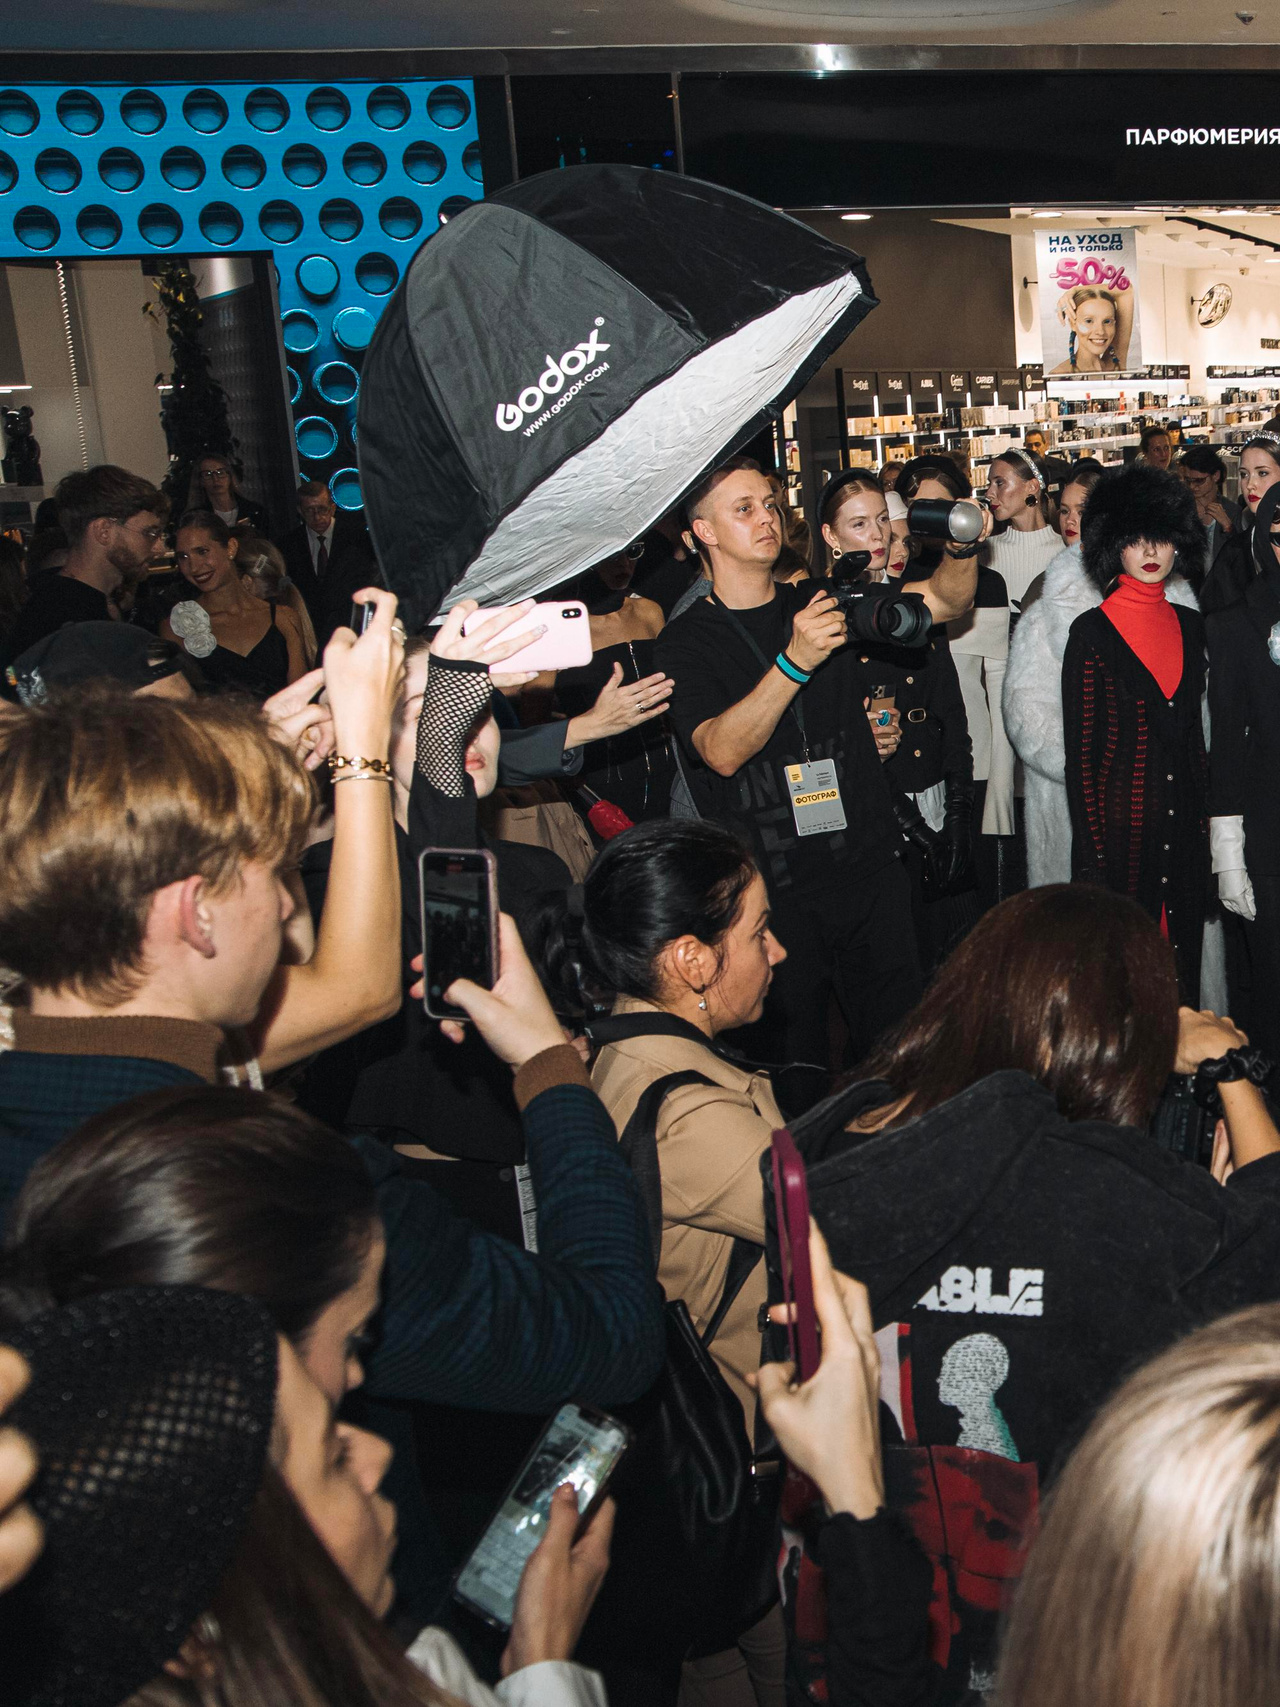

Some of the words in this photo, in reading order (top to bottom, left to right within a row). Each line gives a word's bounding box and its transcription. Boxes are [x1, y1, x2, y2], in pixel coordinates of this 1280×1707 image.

[1048, 236, 1072, 246] НА
[1076, 233, 1123, 245] УХОД
[1078, 243, 1124, 252] только
[523, 362, 610, 437] WWW.GODOX.COM
[795, 790, 837, 805] ФОТОГРАФ
